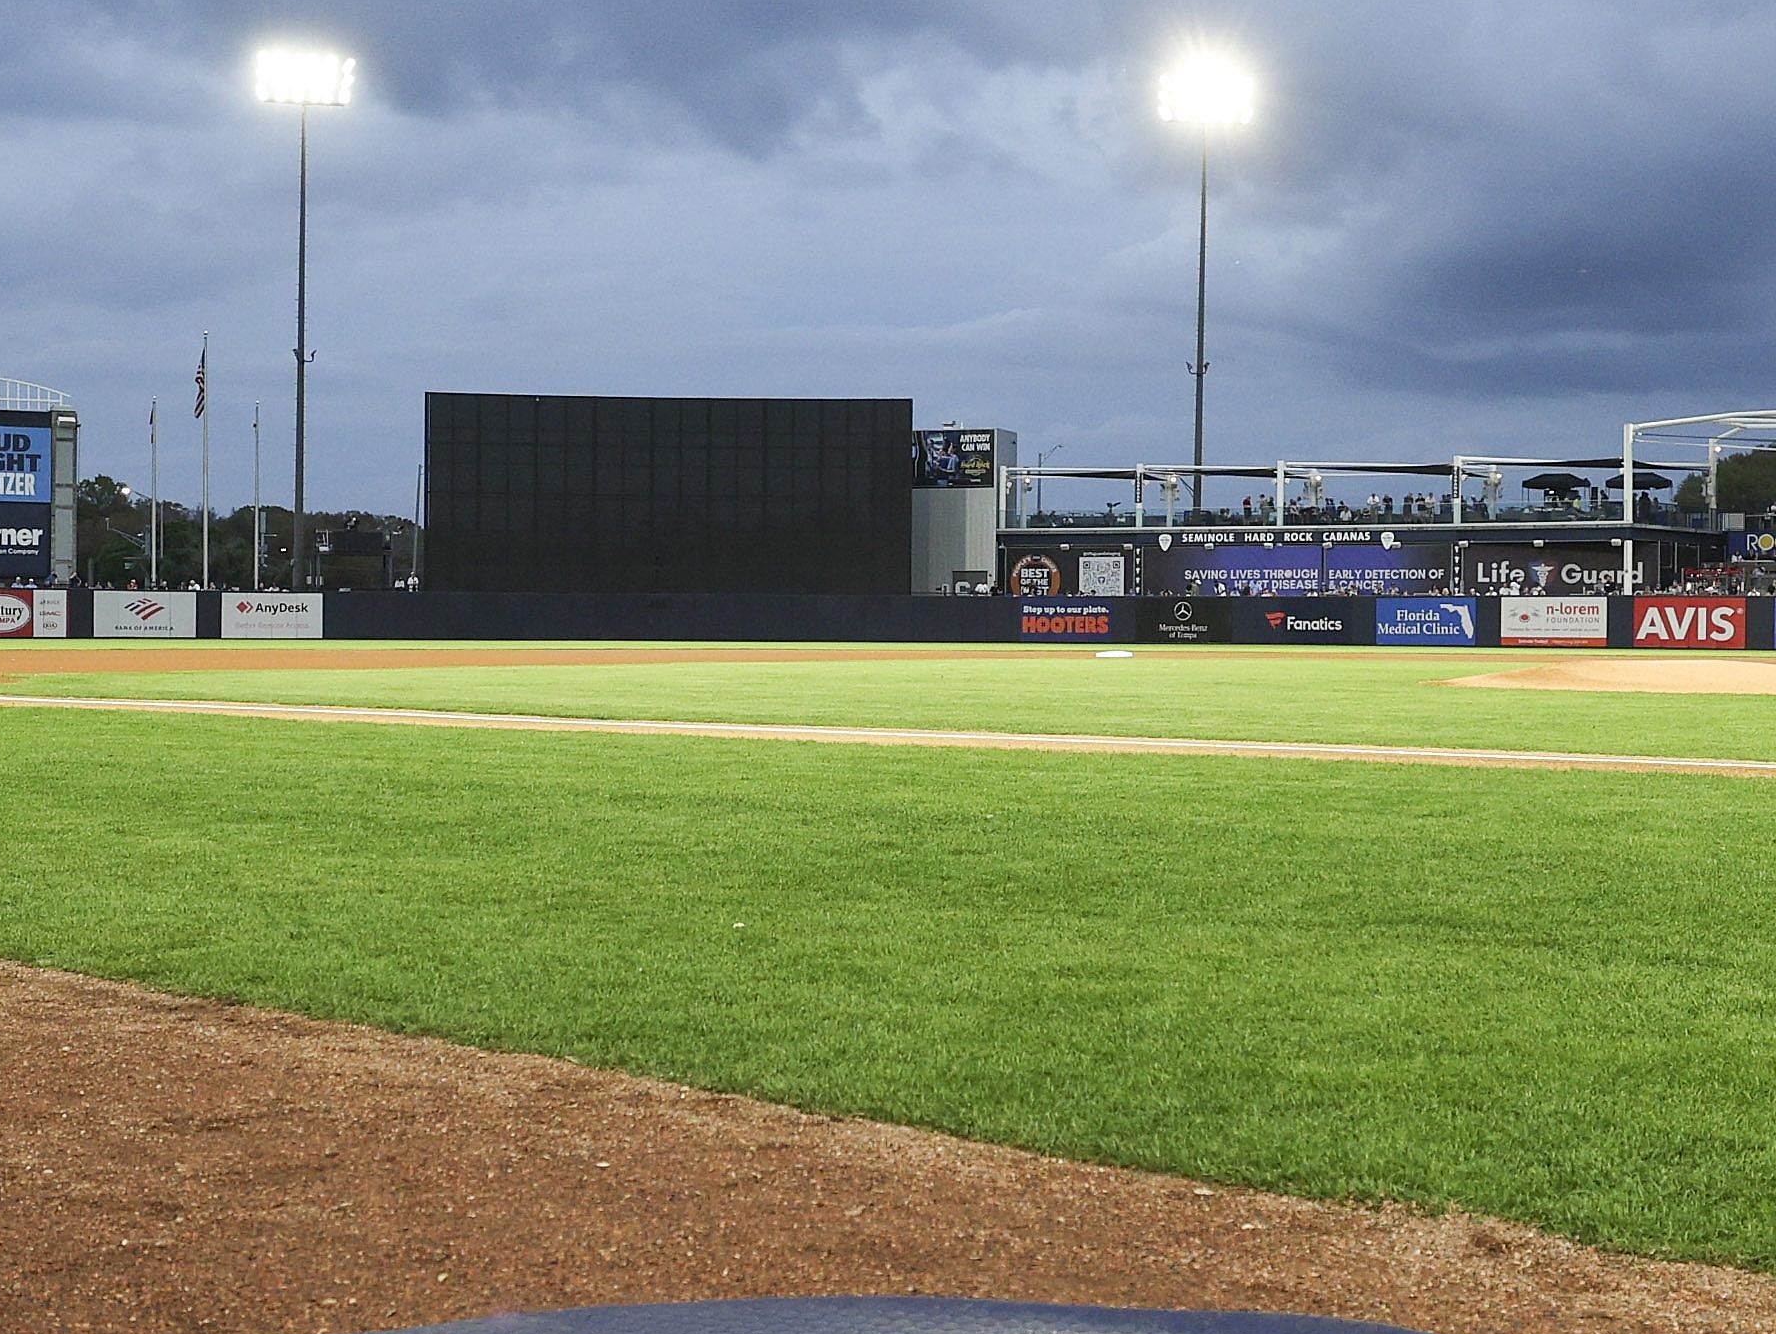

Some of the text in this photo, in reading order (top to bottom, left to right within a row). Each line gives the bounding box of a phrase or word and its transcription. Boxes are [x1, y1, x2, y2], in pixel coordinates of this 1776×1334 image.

[960, 434, 991, 443] ANYBODY
[961, 443, 991, 451] CAN WIN
[1181, 531, 1371, 543] SEMINOLE HARD ROCK CABANAS
[7, 548, 39, 556] Company
[1020, 568, 1050, 578] BEST
[1184, 569, 1319, 580] SAVING LIVES THROUGH
[1328, 569, 1445, 580] EARLY DETECTION OF
[1476, 560, 1643, 584] Life Guard
[1032, 578, 1049, 586] THE
[1272, 580, 1318, 590] DISEASE
[255, 602, 309, 616] AnyDesk
[1022, 605, 1043, 615] Step
[1044, 607, 1056, 615] up
[1056, 606, 1065, 614] to
[1546, 602, 1600, 615] n-lorem
[1396, 609, 1440, 621] Florida
[1021, 616, 1110, 634] HOOTERS
[1286, 616, 1343, 631] Fanatics
[1377, 622, 1460, 635] Medical Clinic
[1635, 606, 1736, 642] AVIS
